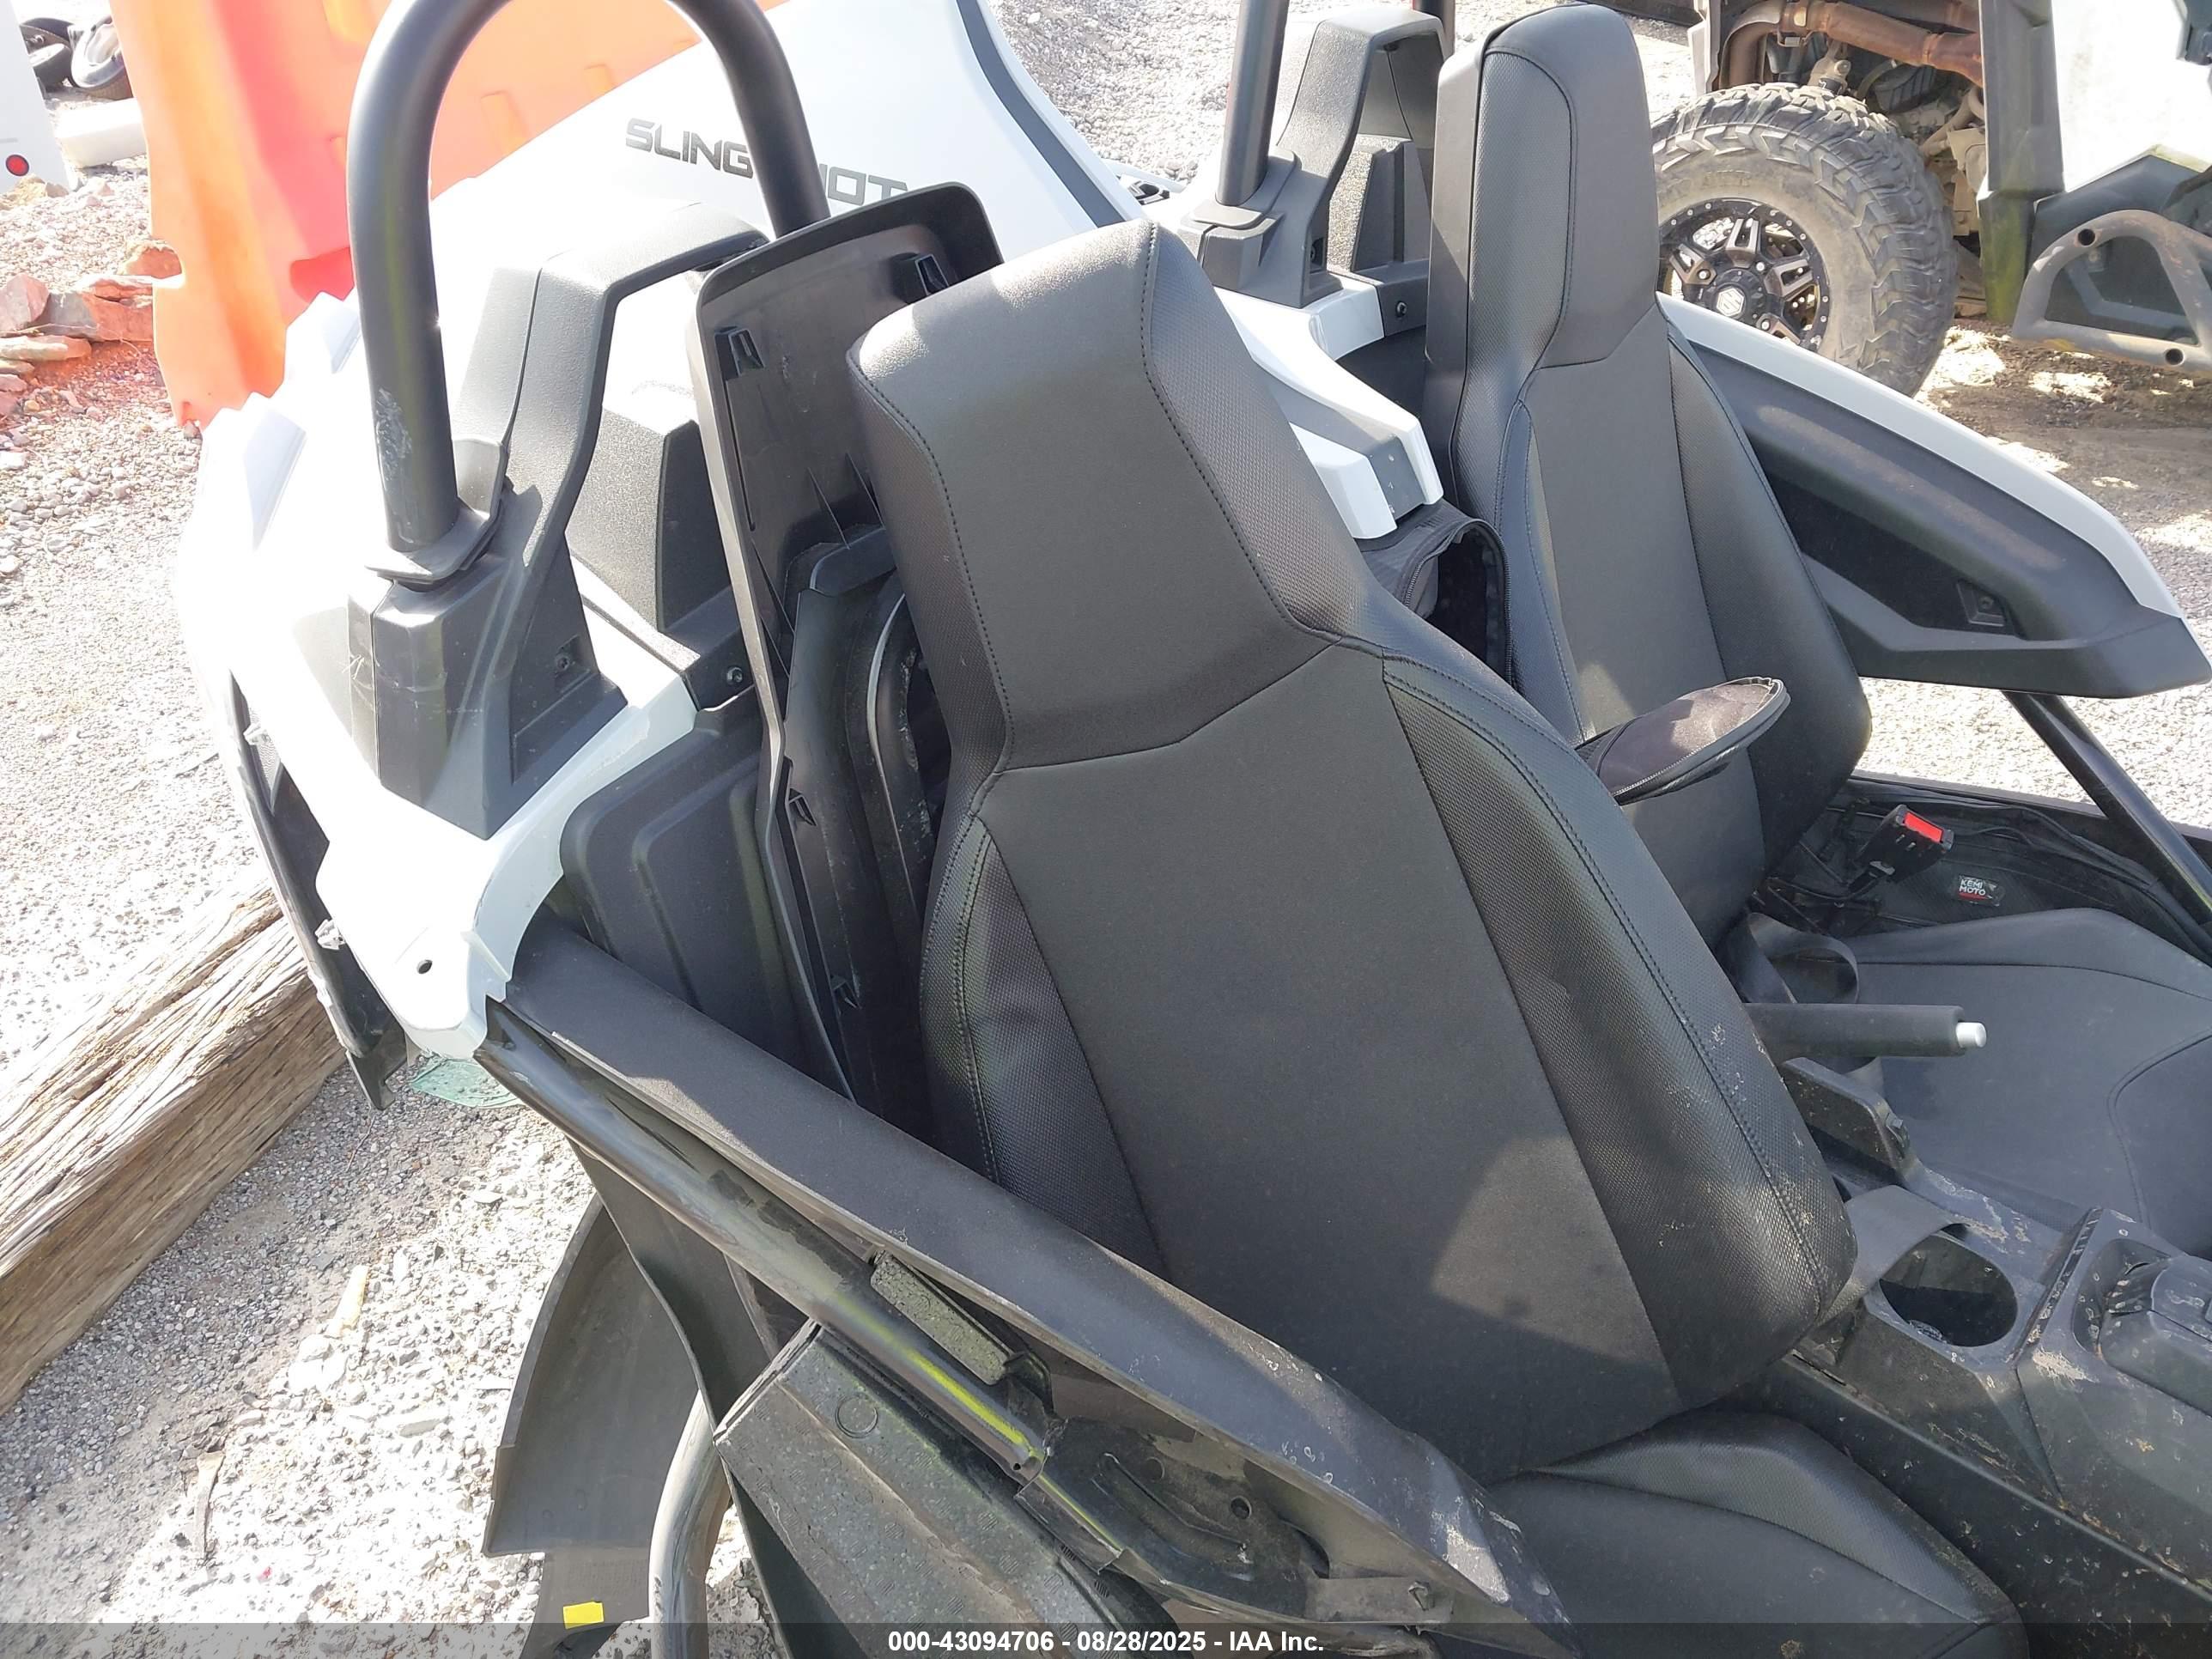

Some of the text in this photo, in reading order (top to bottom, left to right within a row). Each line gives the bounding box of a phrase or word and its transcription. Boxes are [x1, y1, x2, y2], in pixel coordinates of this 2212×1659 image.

[625, 117, 908, 205] SLINGOT
[1960, 879, 1984, 889] KEMI
[1959, 885, 1986, 896] MOTO
